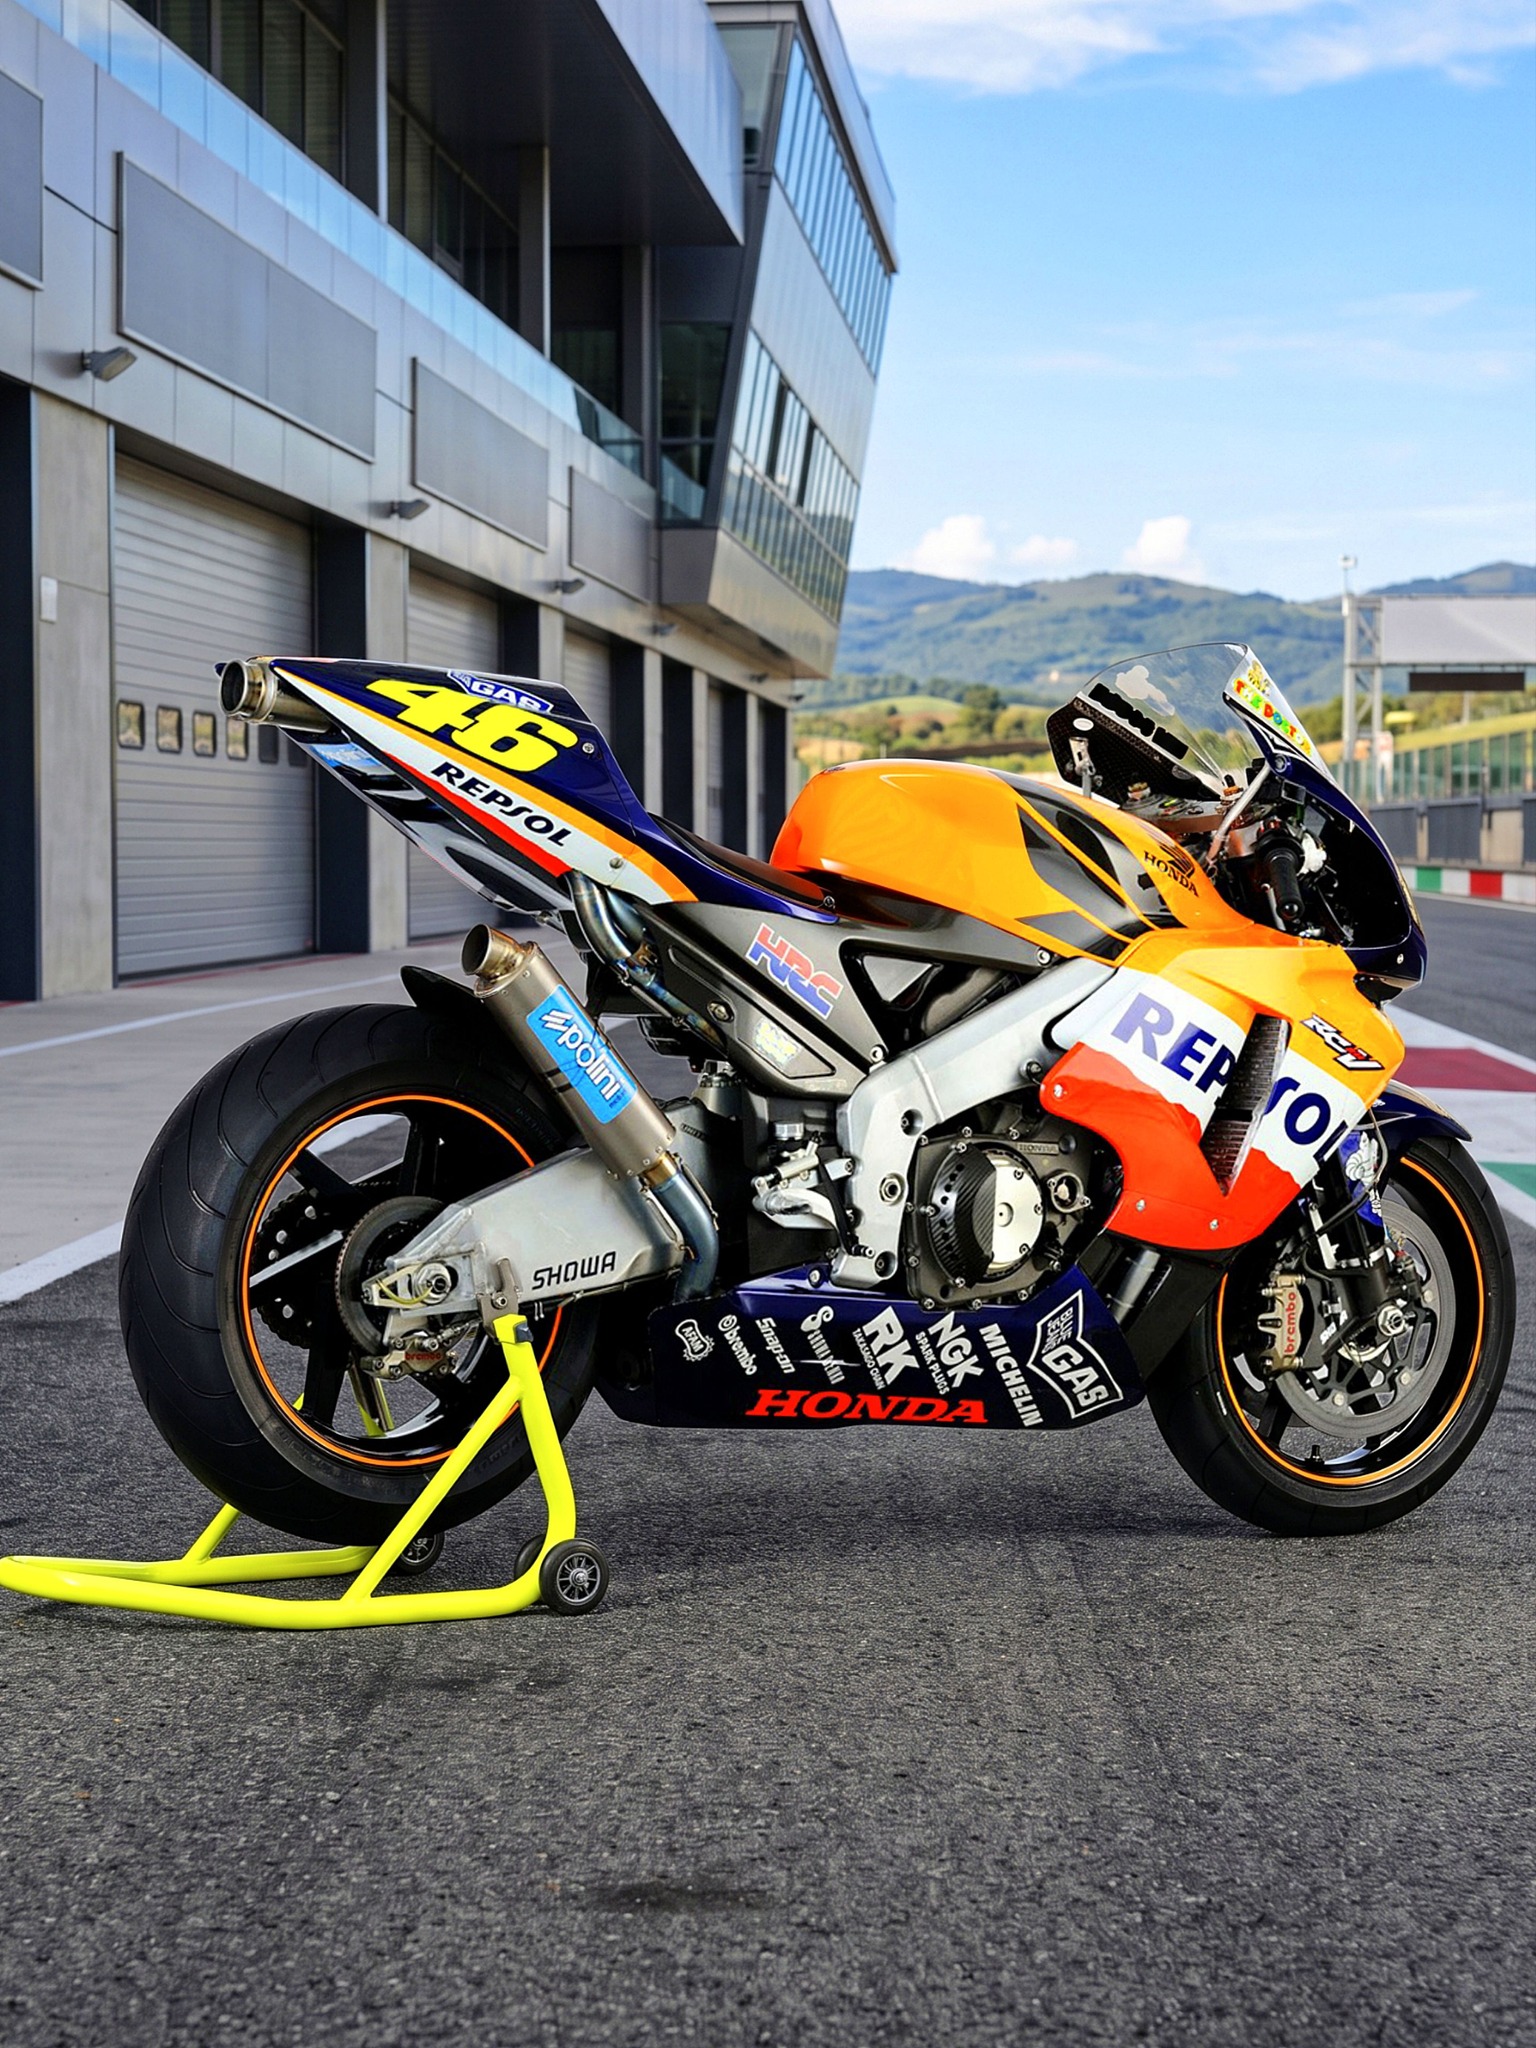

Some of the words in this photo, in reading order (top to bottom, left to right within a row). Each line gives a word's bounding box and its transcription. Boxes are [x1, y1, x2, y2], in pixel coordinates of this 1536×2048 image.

[365, 679, 579, 772] 46
[1233, 678, 1262, 710] THE
[430, 761, 572, 847] REPSOL
[1144, 850, 1200, 898] HONDA
[746, 923, 844, 1020] HRC
[556, 1023, 625, 1102] polini
[532, 1250, 616, 1290] SHOWA
[682, 1326, 704, 1353] AFAM
[724, 1325, 758, 1376] brembo
[755, 1316, 796, 1374] Snap-on
[852, 1327, 876, 1369] TAKASAGO
[862, 1305, 920, 1386] RK
[927, 1310, 985, 1389] NGK
[1284, 1292, 1297, 1354] brembo
[915, 1330, 937, 1365] SPARK
[928, 1362, 951, 1396] PLUGS
[979, 1322, 1044, 1428] MICHELIN
[1041, 1344, 1110, 1408] GAS
[746, 1389, 989, 1424] HONDA
